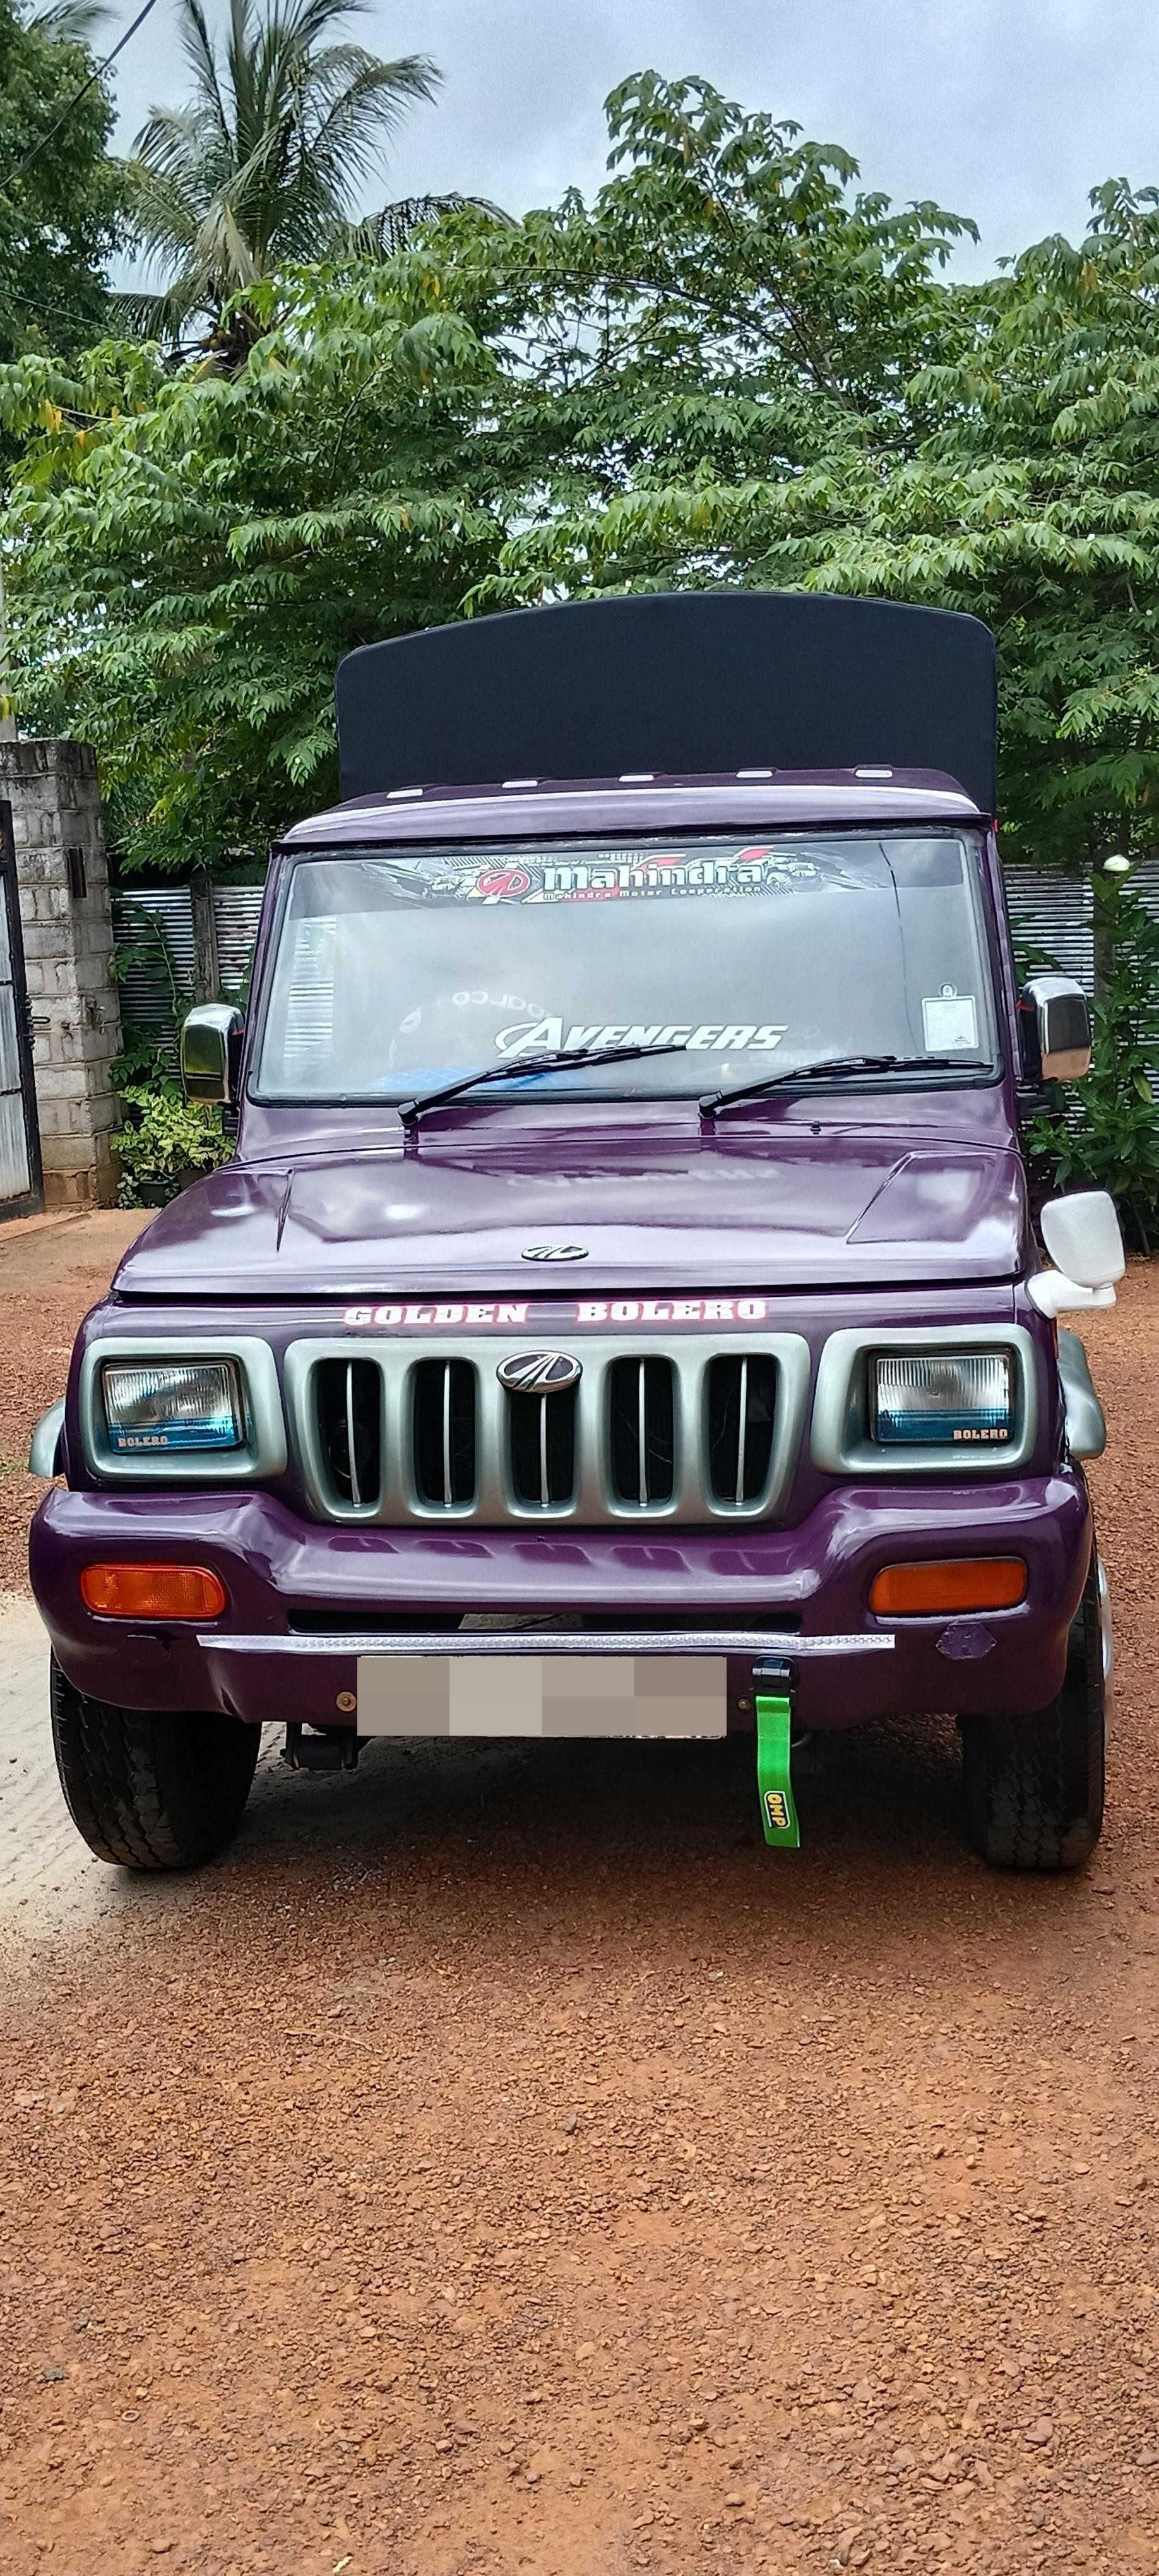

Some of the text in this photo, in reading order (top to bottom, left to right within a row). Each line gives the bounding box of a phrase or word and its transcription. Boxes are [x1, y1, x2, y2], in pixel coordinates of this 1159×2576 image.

[544, 861, 763, 891] mahindra
[619, 890, 663, 898] Motor
[451, 990, 554, 1021] parco
[495, 1017, 789, 1059] AVENGERS
[343, 1299, 767, 1326] GOLDEN BOLERO
[117, 1434, 168, 1448] BOLERO
[953, 1428, 1008, 1440] BOLERO
[767, 1793, 787, 1827] OMP
